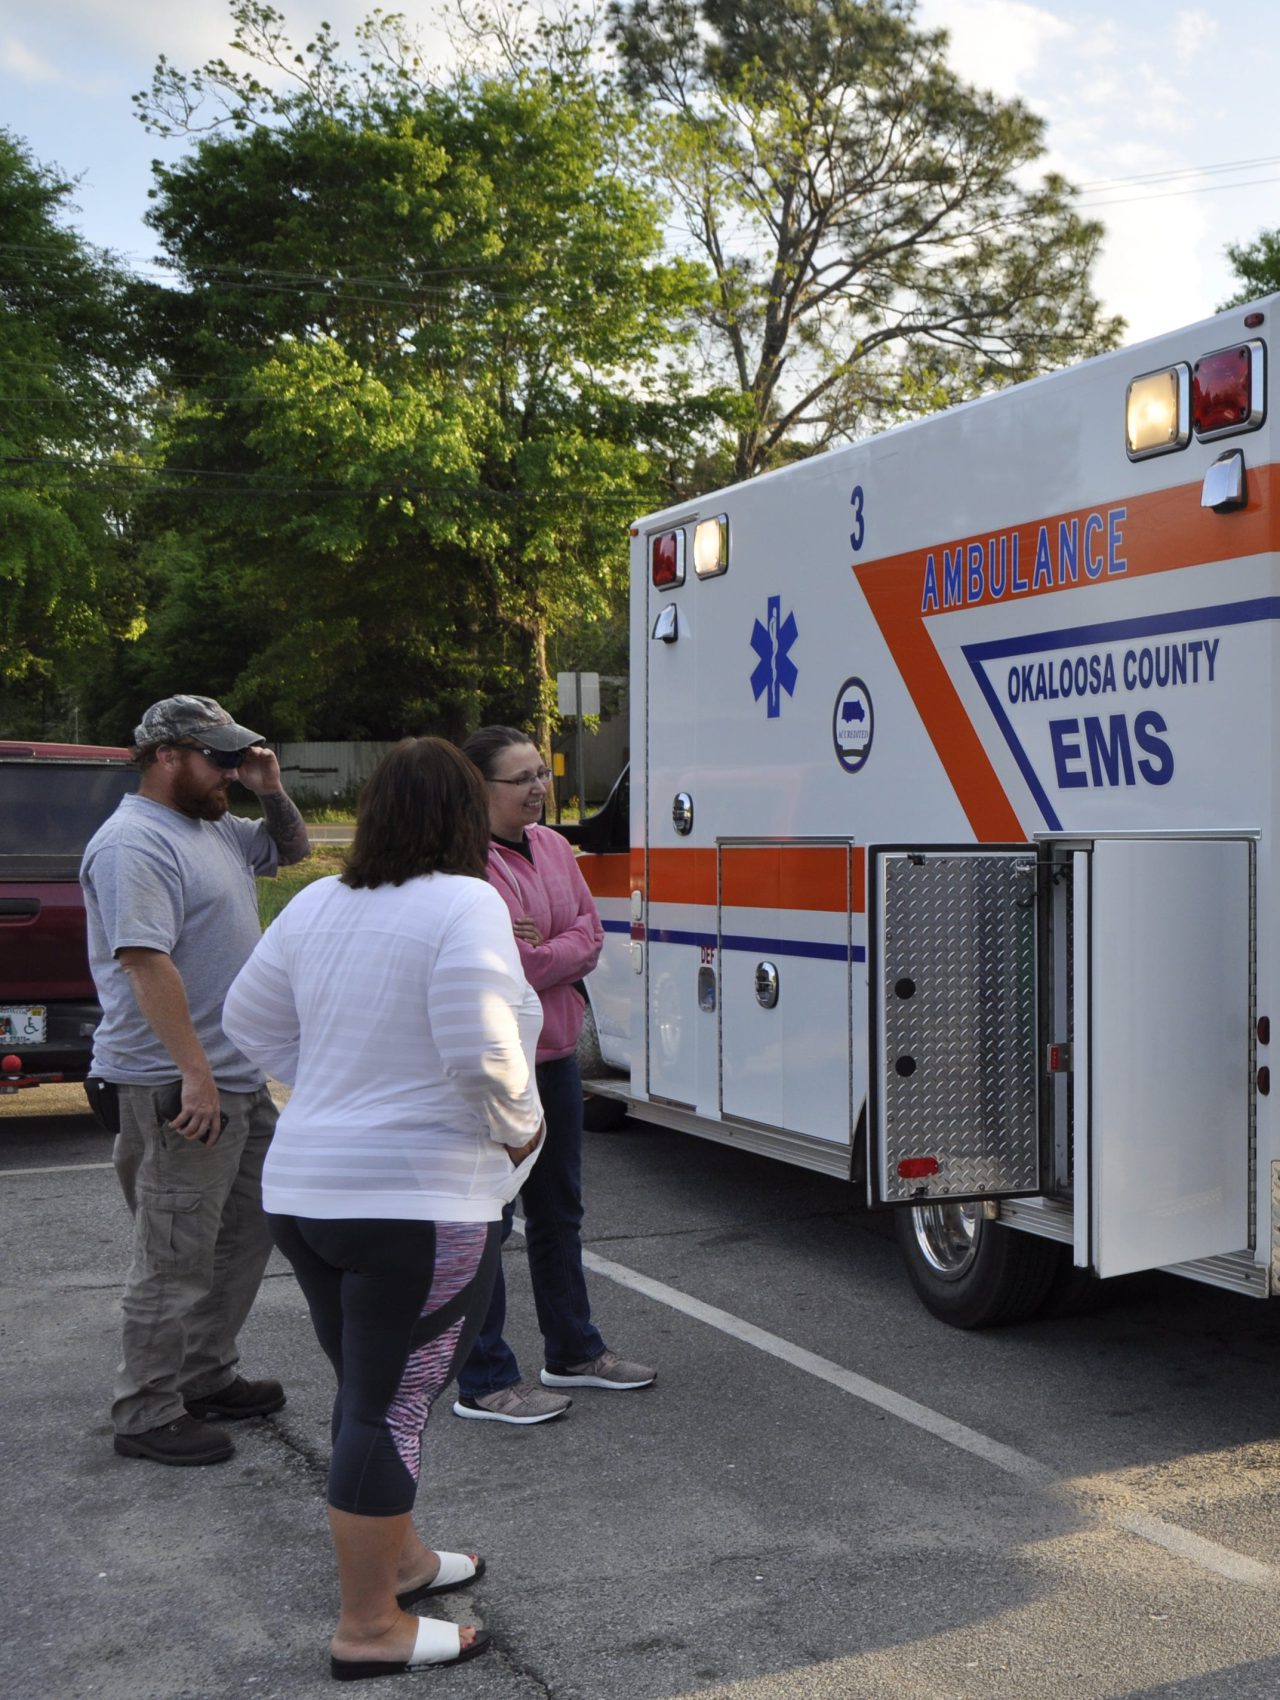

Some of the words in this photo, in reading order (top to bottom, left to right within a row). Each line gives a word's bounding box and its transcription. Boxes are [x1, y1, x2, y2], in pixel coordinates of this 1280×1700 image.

[850, 485, 864, 551] 3
[921, 506, 1128, 612] AMBULANCE
[1008, 654, 1116, 704] OKALOOSA
[1123, 638, 1220, 690] COUNTY
[838, 729, 868, 739] ACCREDITED
[1048, 710, 1175, 789] EMS
[700, 945, 714, 965] DEF
